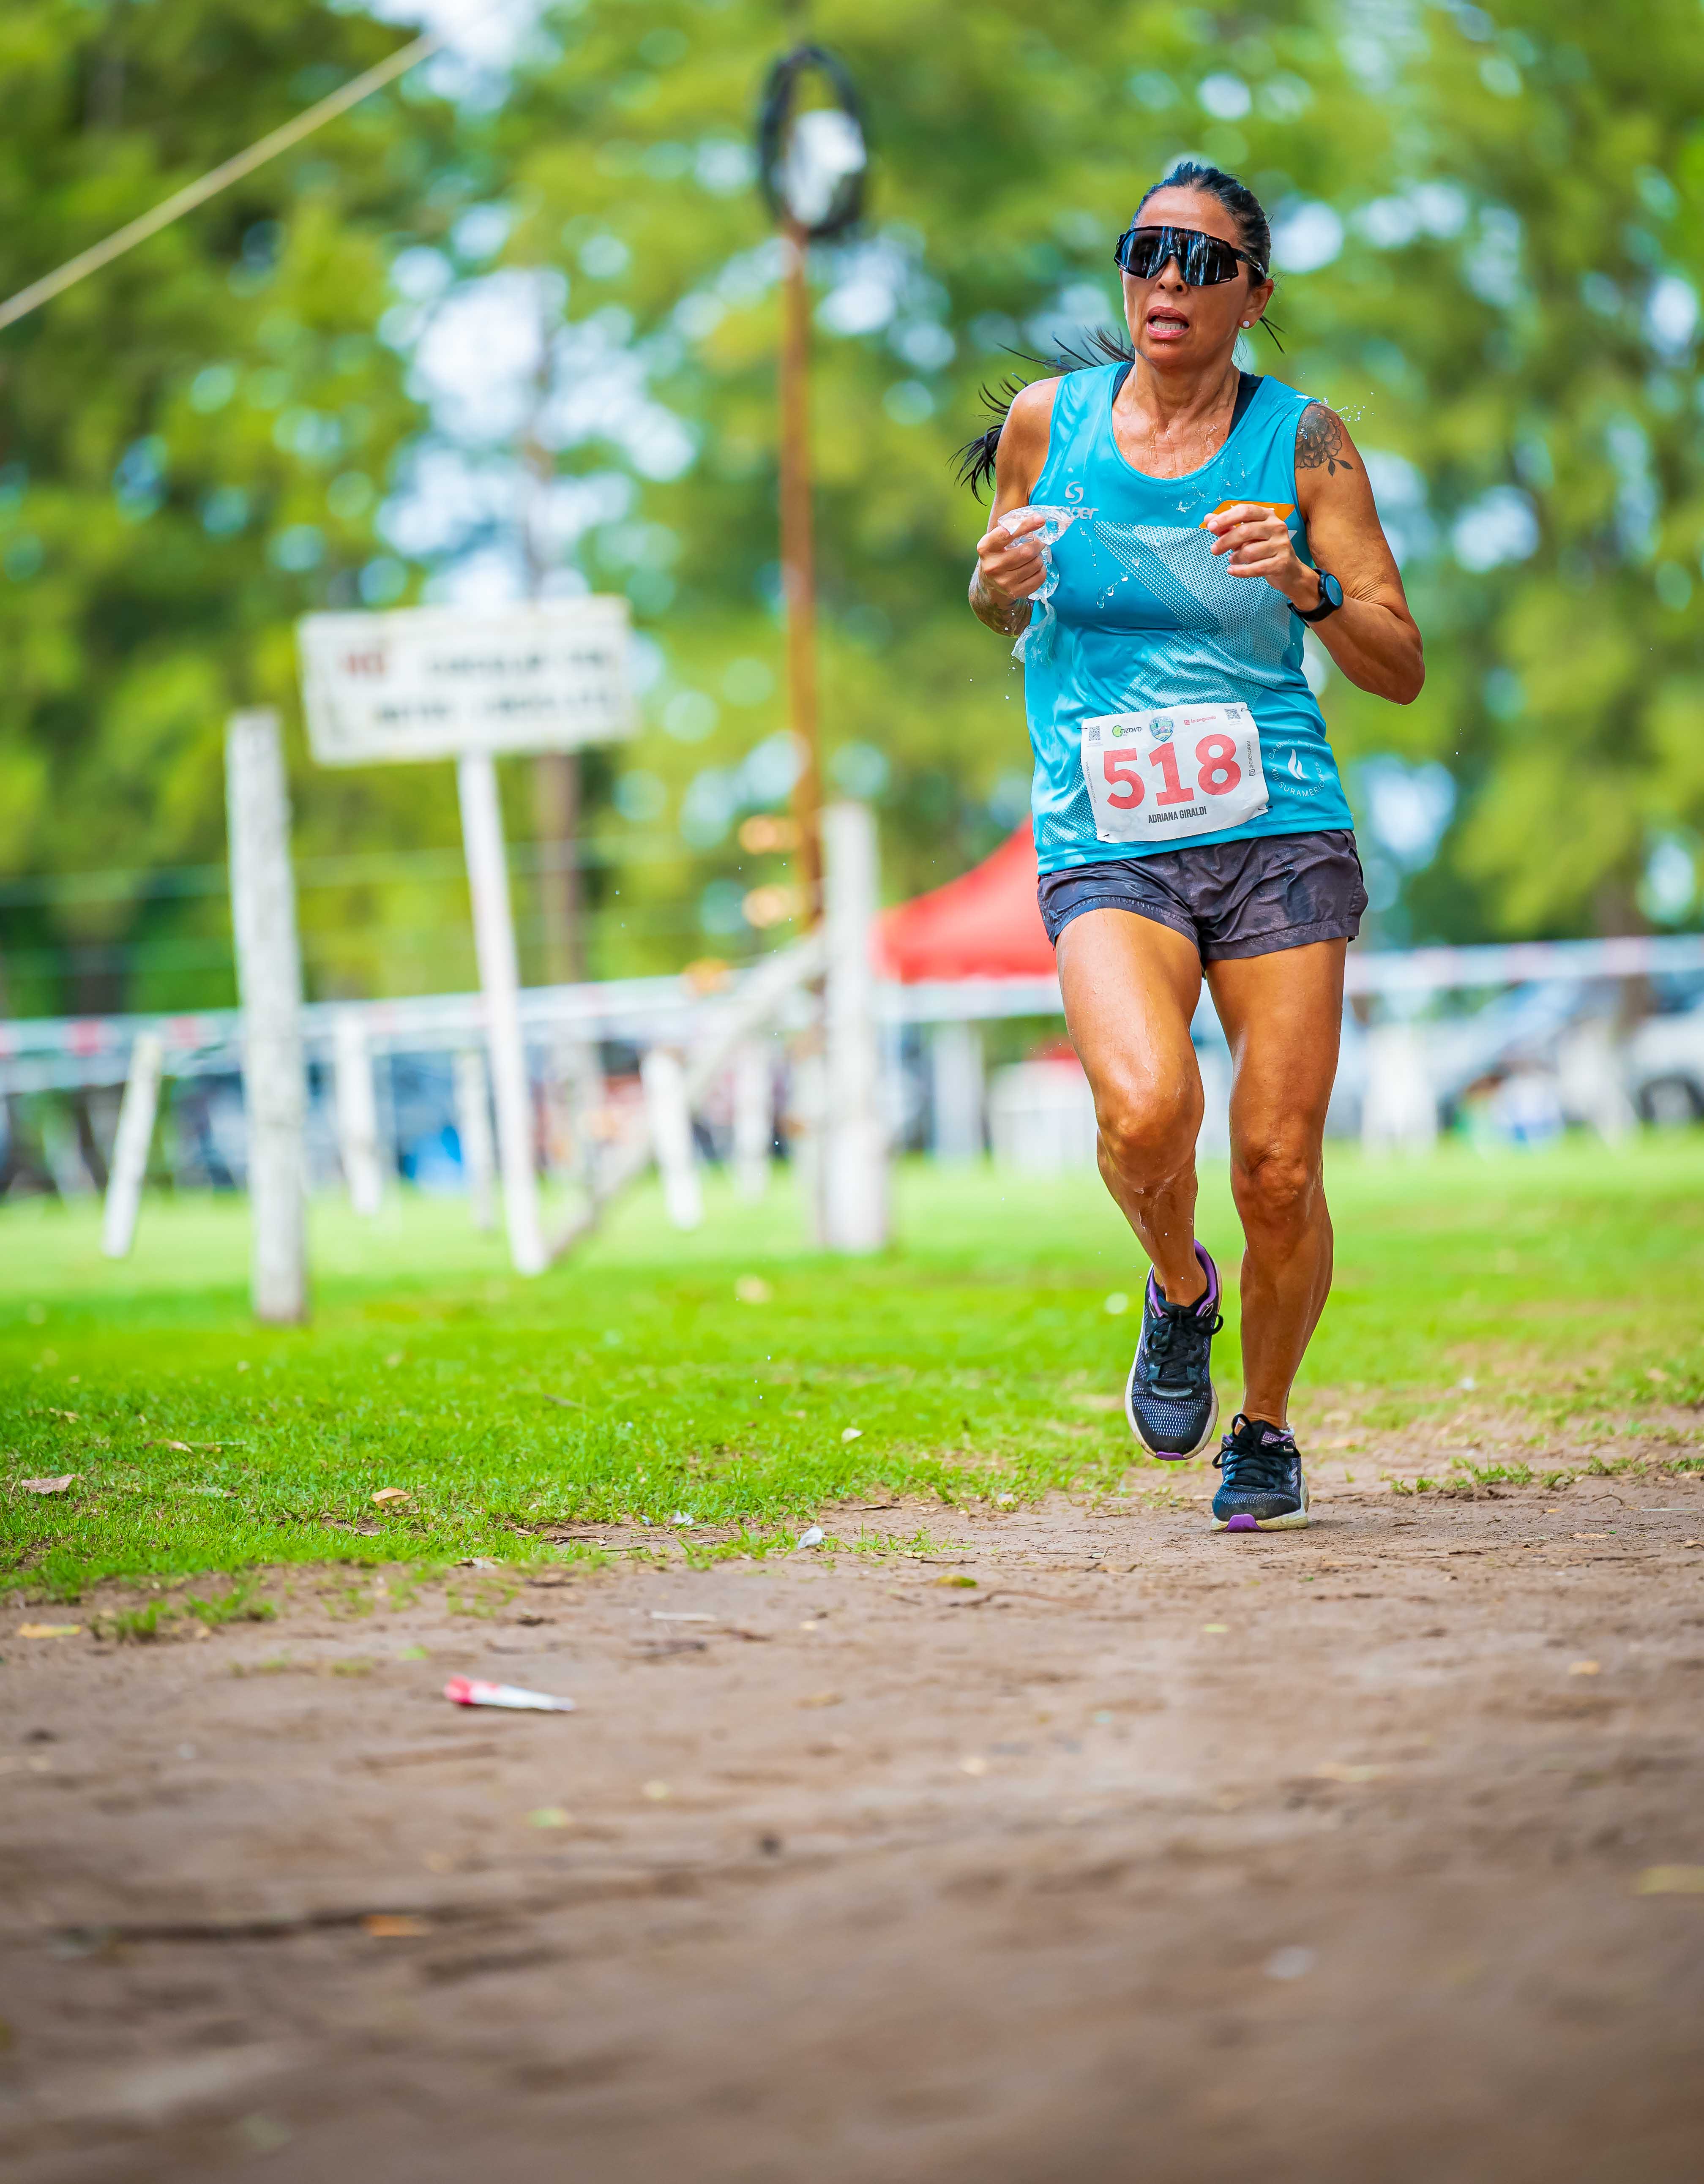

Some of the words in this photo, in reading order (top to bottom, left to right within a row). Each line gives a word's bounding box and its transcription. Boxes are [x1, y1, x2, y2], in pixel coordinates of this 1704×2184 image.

[1103, 734, 1241, 810] 518
[1271, 767, 1281, 781] XIII
[1148, 811, 1178, 823] ADRIANA
[1179, 806, 1207, 819] GIRALDI
